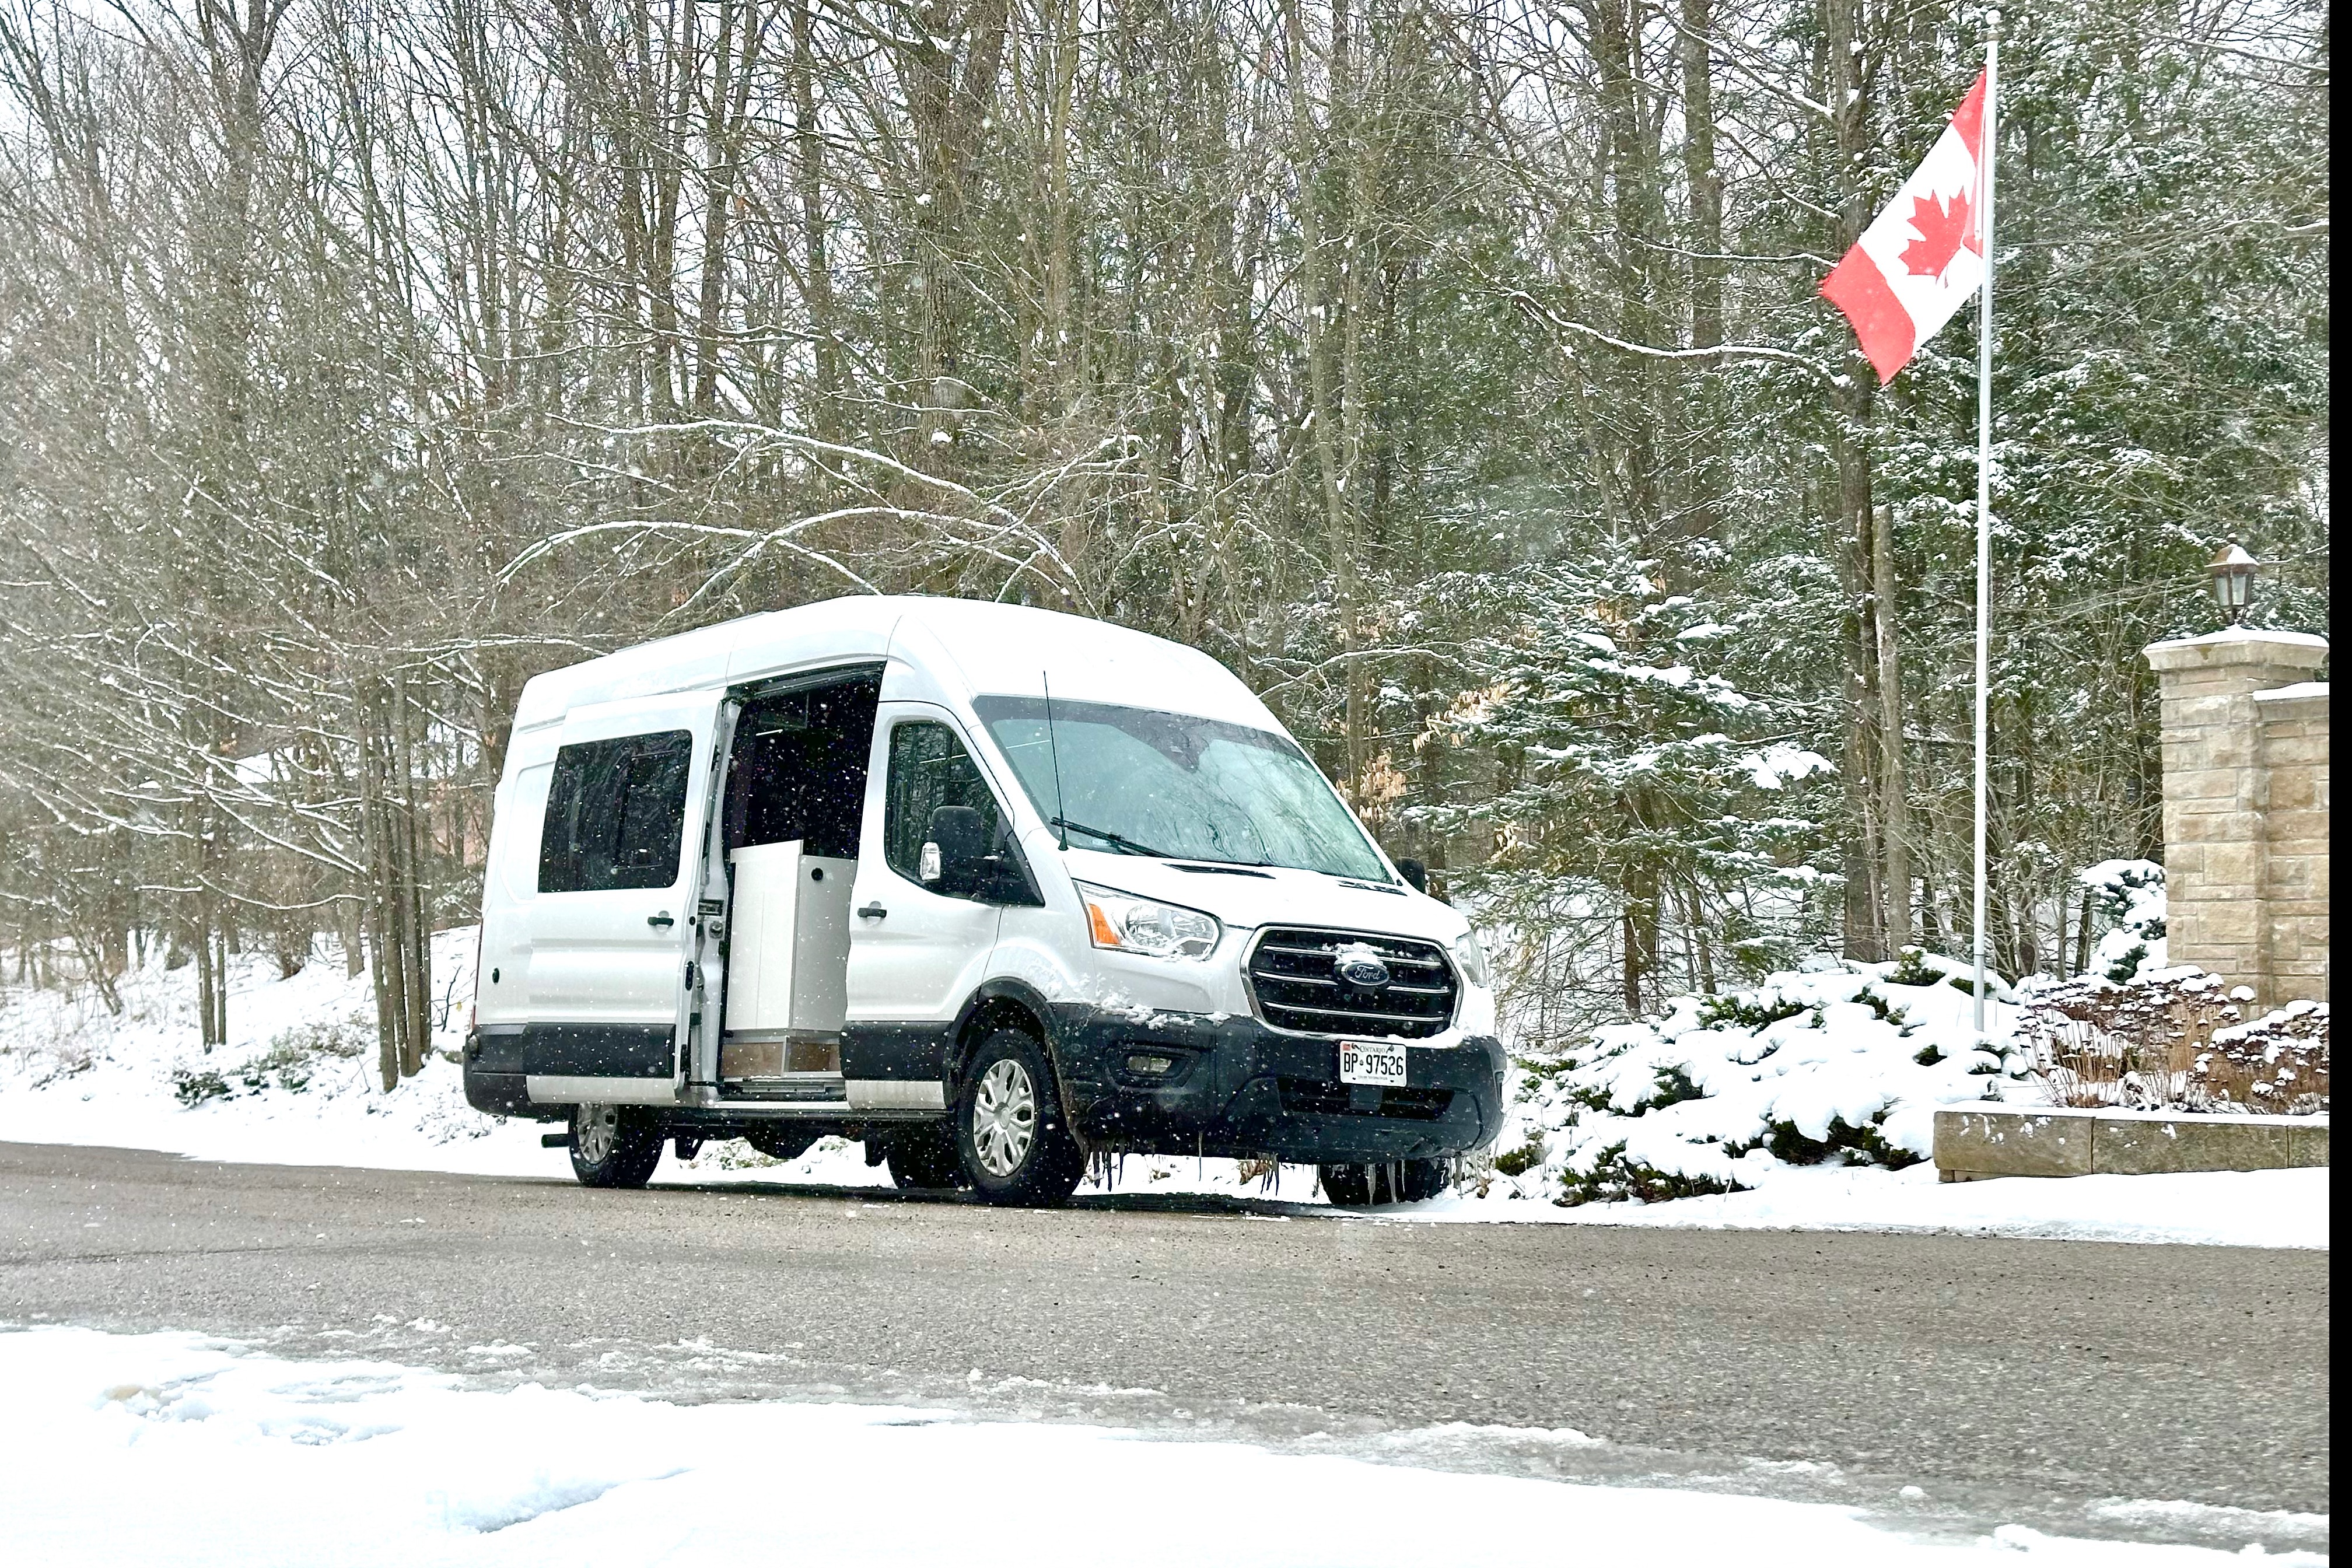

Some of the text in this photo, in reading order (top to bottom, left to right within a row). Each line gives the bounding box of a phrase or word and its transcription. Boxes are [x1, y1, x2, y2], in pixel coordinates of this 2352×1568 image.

[1354, 965, 1381, 980] Ford
[1360, 1045, 1386, 1054] ONTARIO
[1344, 1052, 1404, 1076] BP 97526
